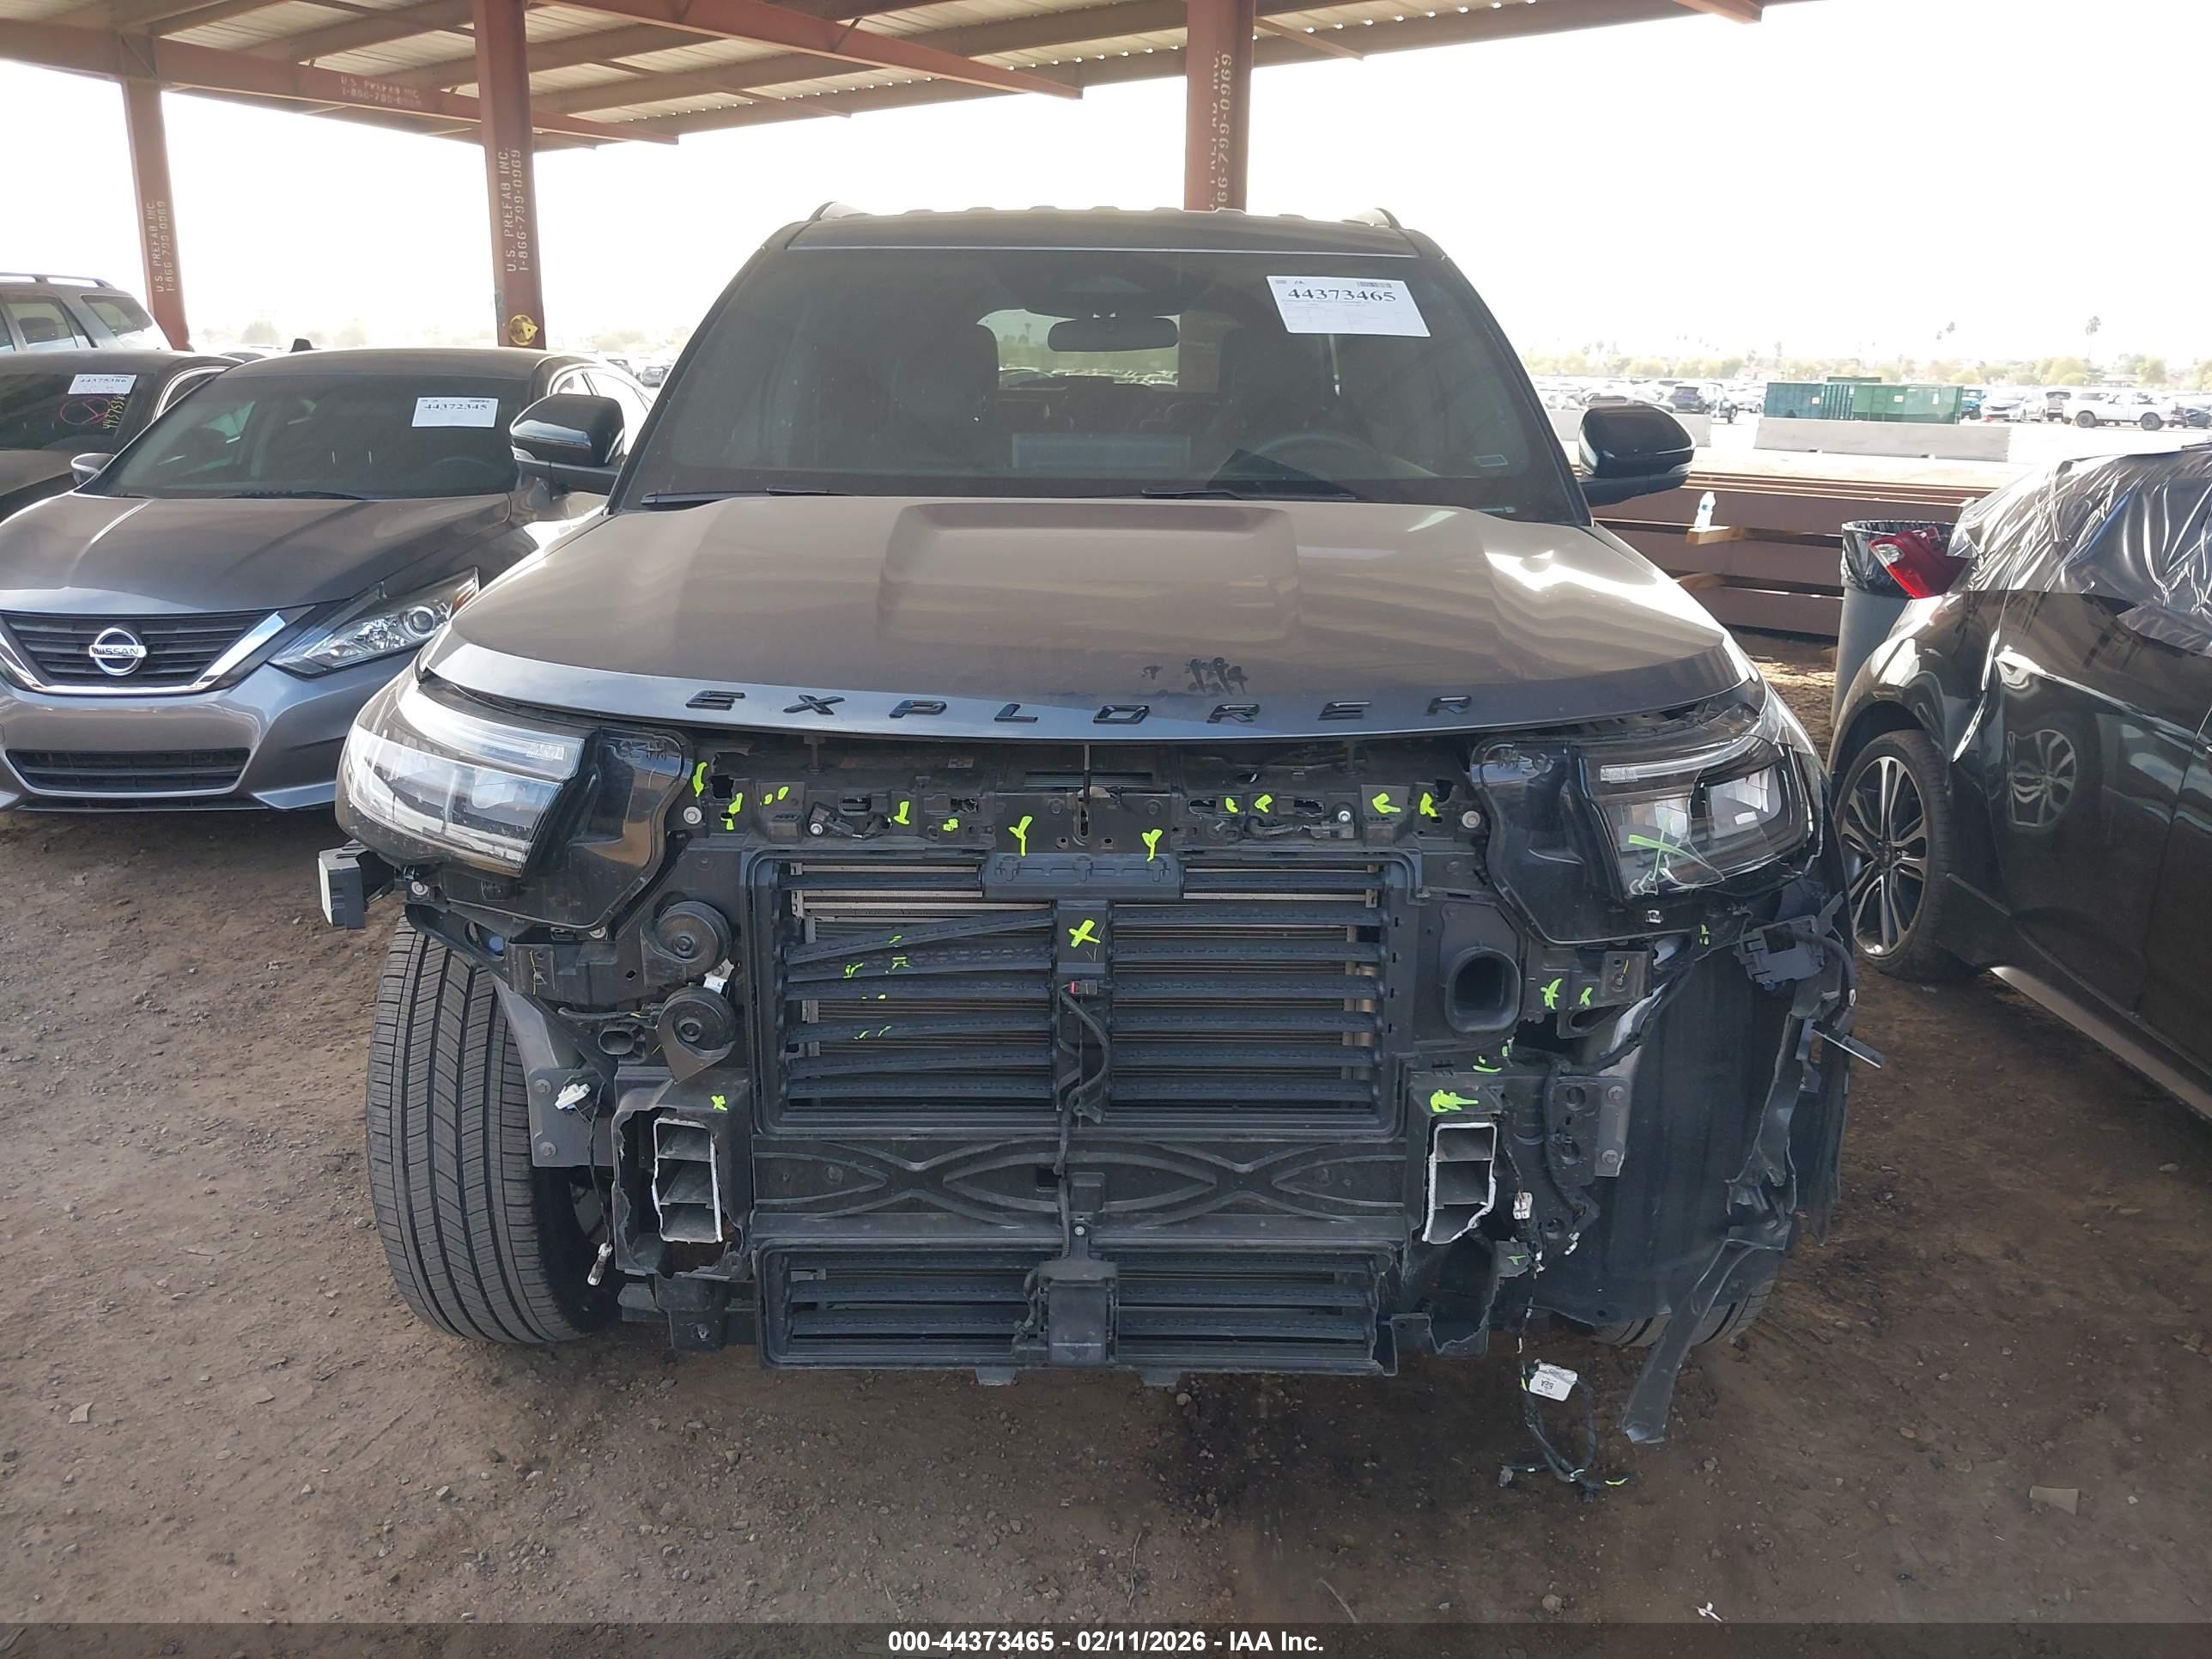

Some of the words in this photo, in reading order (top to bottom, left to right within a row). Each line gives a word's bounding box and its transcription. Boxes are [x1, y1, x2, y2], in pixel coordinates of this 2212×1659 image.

[1217, 54, 1232, 210] 66-799-0969
[498, 148, 510, 175] INC.
[501, 182, 514, 238] PREFAB
[511, 149, 530, 271] 1-866-799-0969
[149, 225, 162, 267] PREFAB
[505, 246, 517, 272] U.S.
[1288, 289, 1396, 302] 44373465
[91, 647, 139, 655] NISSAN
[685, 690, 1473, 725] EXPLORER
